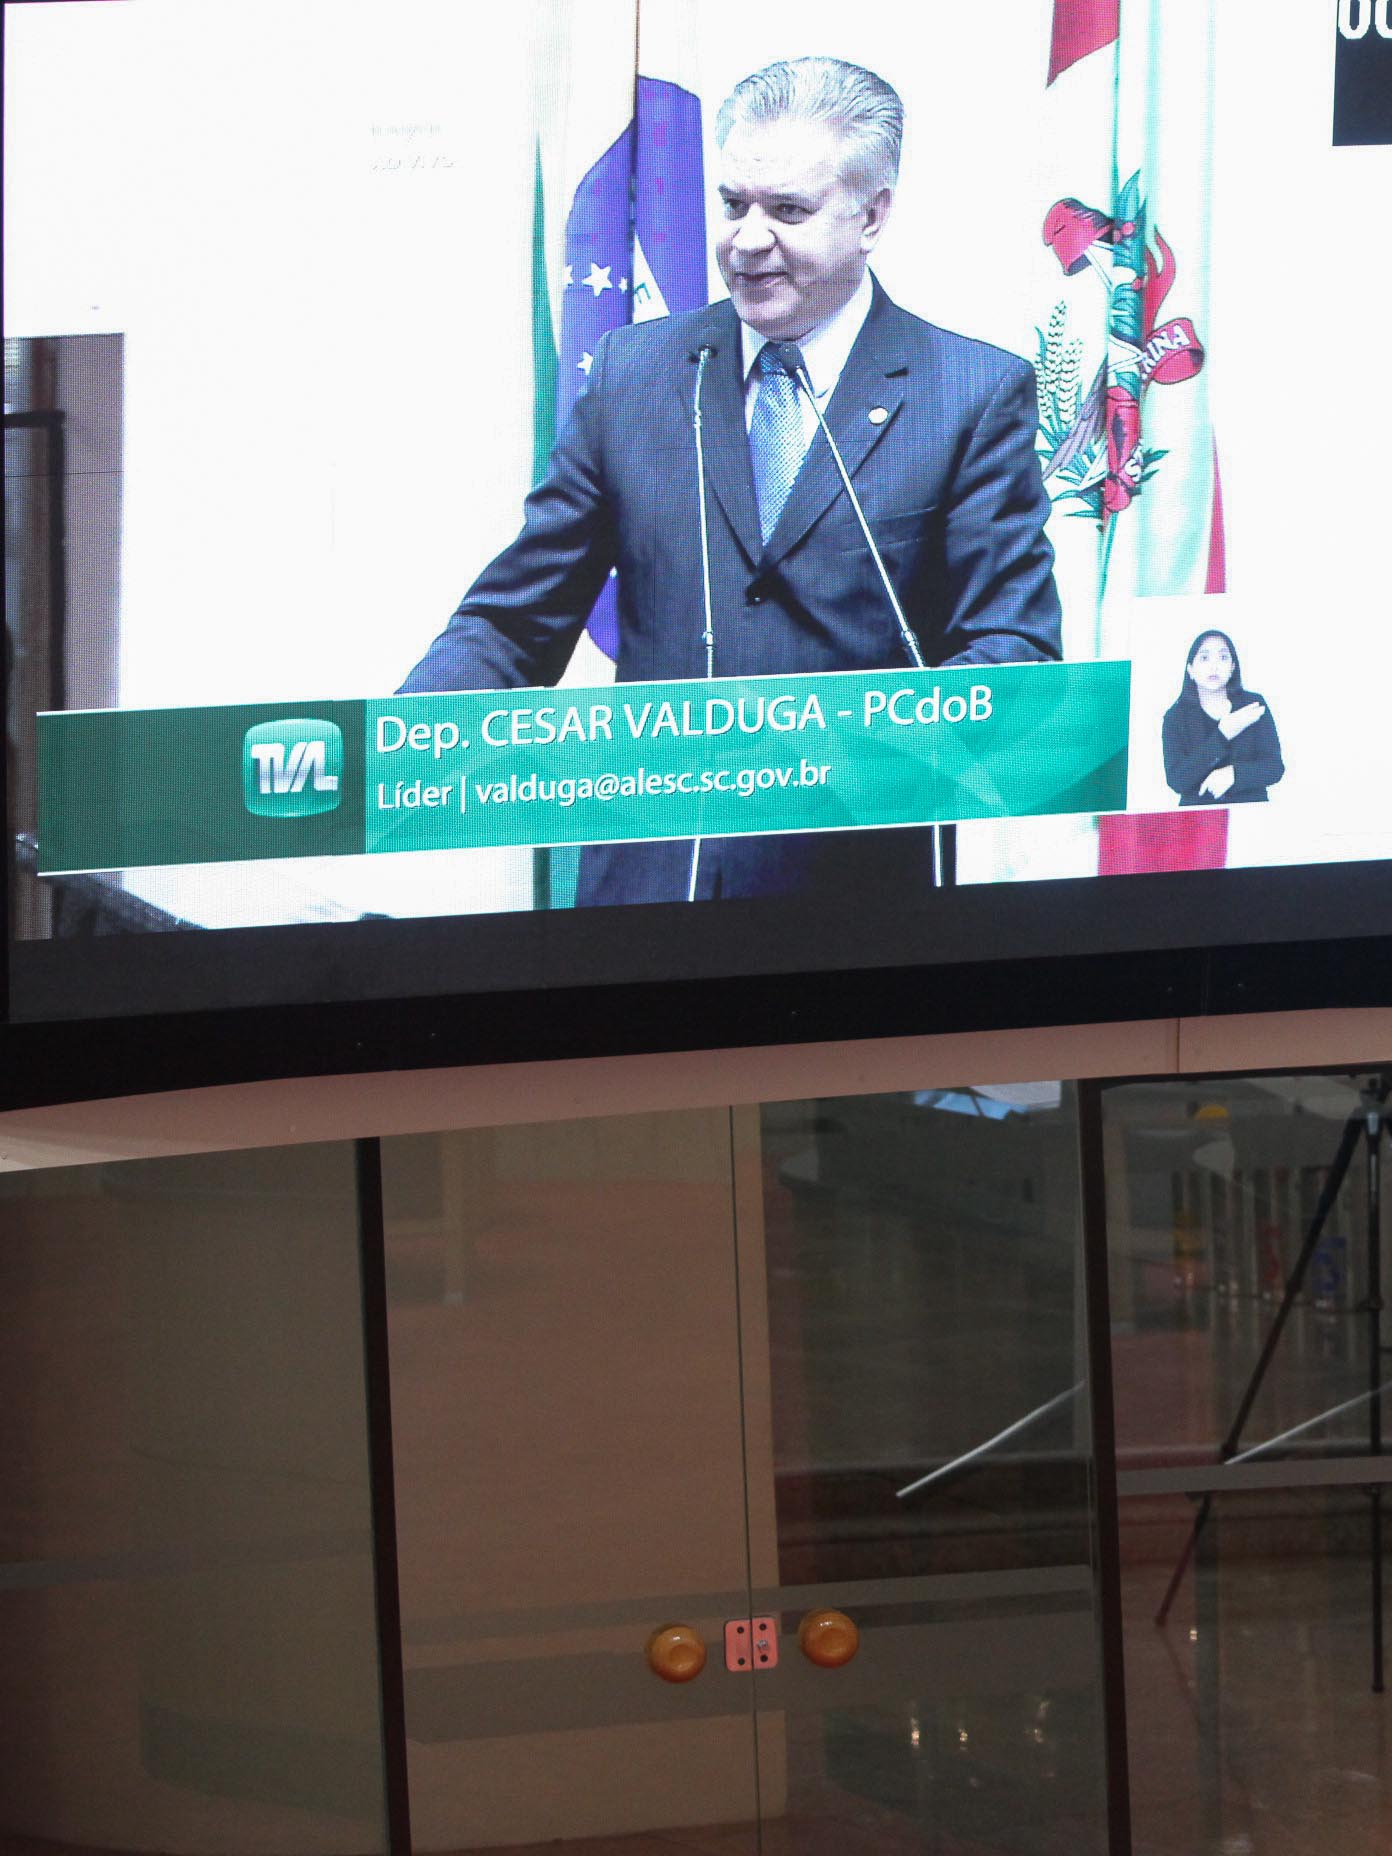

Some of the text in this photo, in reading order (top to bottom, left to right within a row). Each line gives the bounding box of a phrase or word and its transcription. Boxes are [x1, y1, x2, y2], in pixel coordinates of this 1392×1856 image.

[376, 715, 470, 759] Dep.
[481, 705, 613, 748] CESAR
[624, 693, 827, 740] VALDUGA
[863, 685, 994, 728] PCdoB
[377, 778, 454, 810] Líder
[475, 758, 832, 807] valduga@alesc.sc.gov.br
